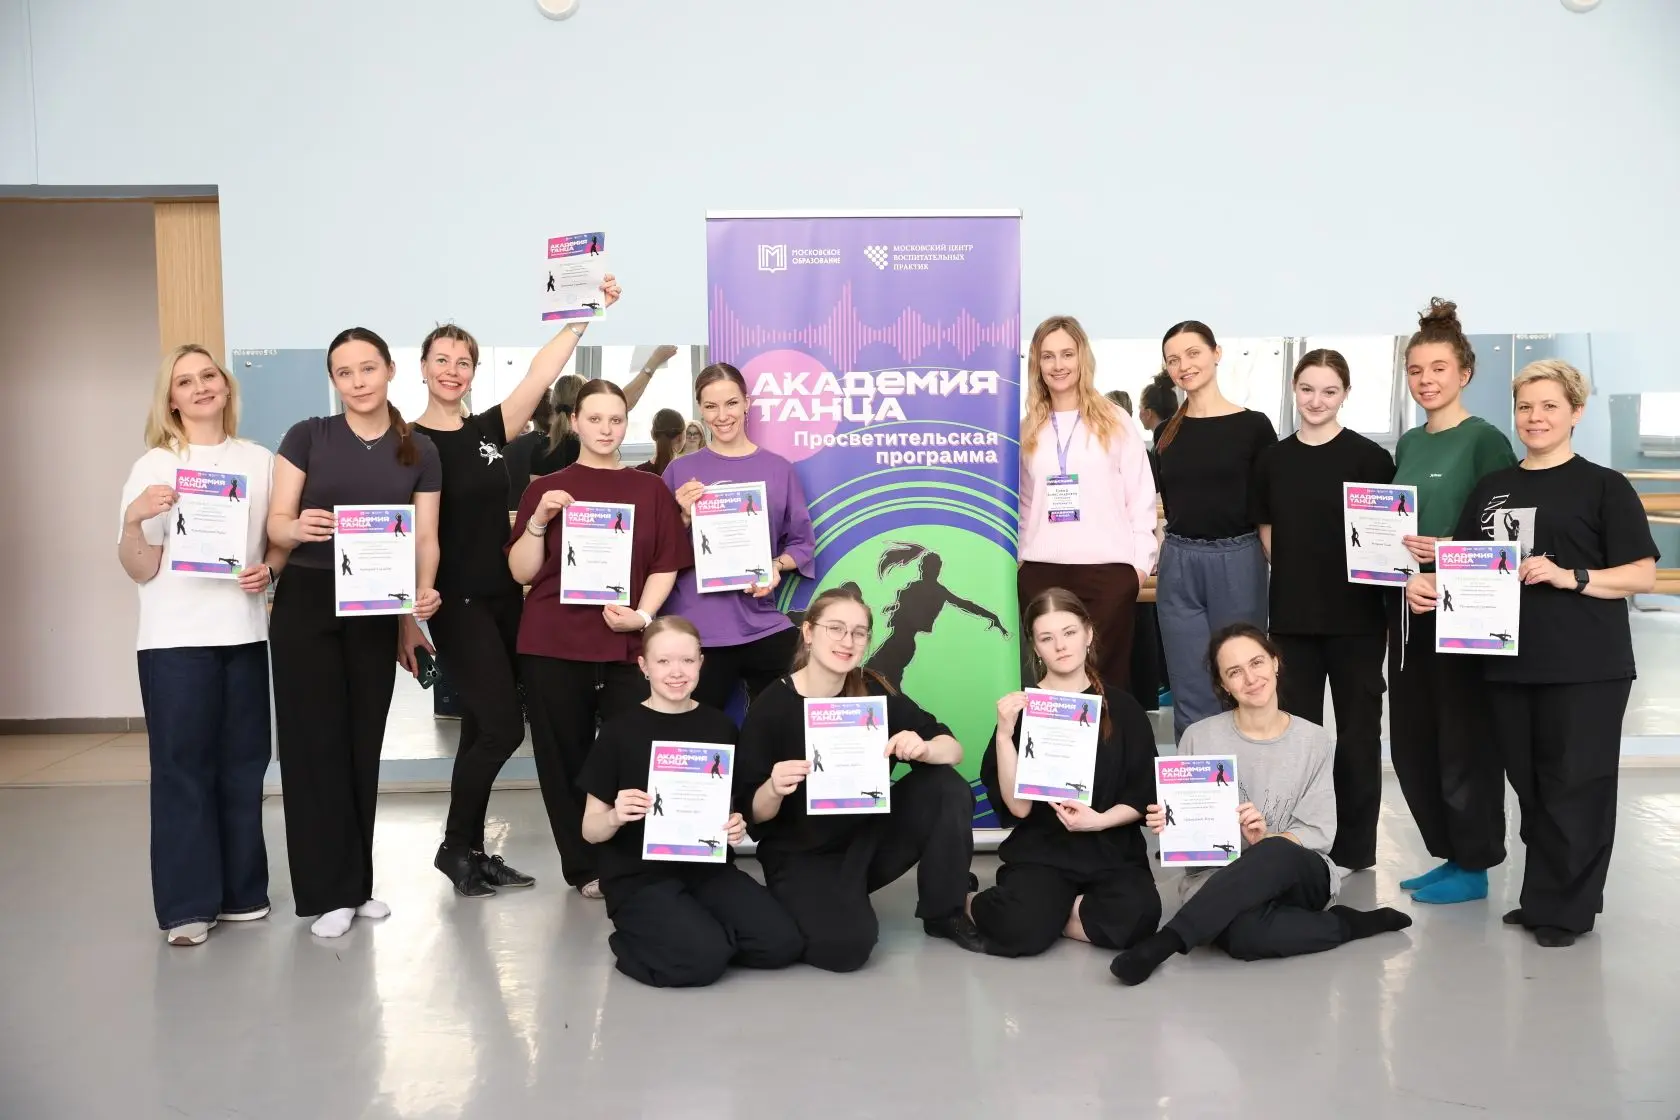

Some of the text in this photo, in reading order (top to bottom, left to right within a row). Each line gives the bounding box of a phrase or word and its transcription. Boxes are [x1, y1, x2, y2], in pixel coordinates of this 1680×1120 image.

[893, 244, 974, 252] МОСКОВСКИЙ ЦЕНТР
[792, 257, 841, 265] ОБРАЗОВАНИЕ
[893, 263, 929, 271] ПРАКТИК
[751, 370, 1001, 398] АКАДЕМИЯ
[752, 397, 908, 426] ТАНЦА
[794, 431, 999, 448] Просветительская
[875, 449, 999, 467] программа
